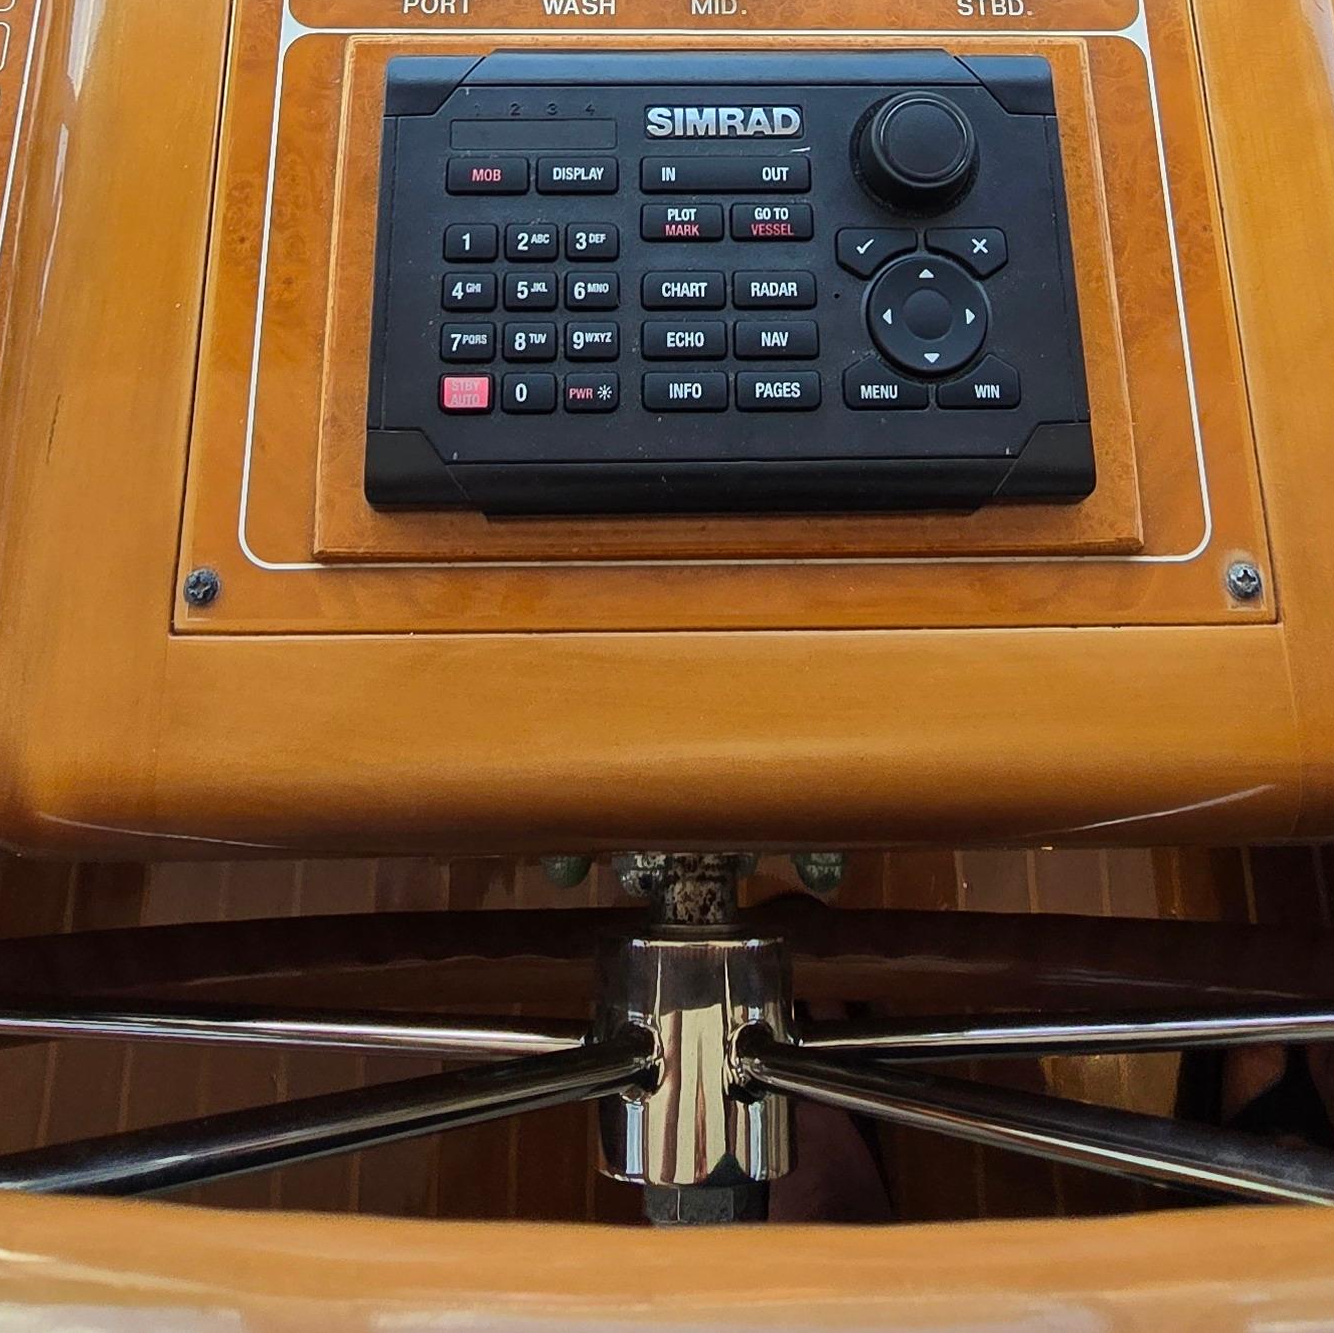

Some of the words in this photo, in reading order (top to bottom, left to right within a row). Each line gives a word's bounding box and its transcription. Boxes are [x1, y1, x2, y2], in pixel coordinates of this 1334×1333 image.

[646, 107, 801, 136] SIMRAD
[472, 169, 501, 181] MOB
[552, 167, 604, 180] DISPLAY
[661, 167, 676, 181] IN
[762, 167, 789, 181] OUT
[667, 209, 696, 221] PLOT
[754, 207, 771, 220] GO
[774, 207, 789, 220] TO
[665, 224, 699, 236] MARK
[750, 223, 794, 235] VESSEL
[461, 233, 471, 250] 1
[661, 282, 707, 297] CHART
[750, 281, 797, 297] RADAR
[666, 332, 705, 347] ECHO
[761, 332, 789, 346] NAV
[515, 383, 527, 402] 0
[569, 388, 593, 399] PWR
[669, 383, 702, 399] INFO
[755, 382, 801, 398] PAGES
[860, 385, 898, 399] MENU
[974, 384, 1000, 398] WIN
